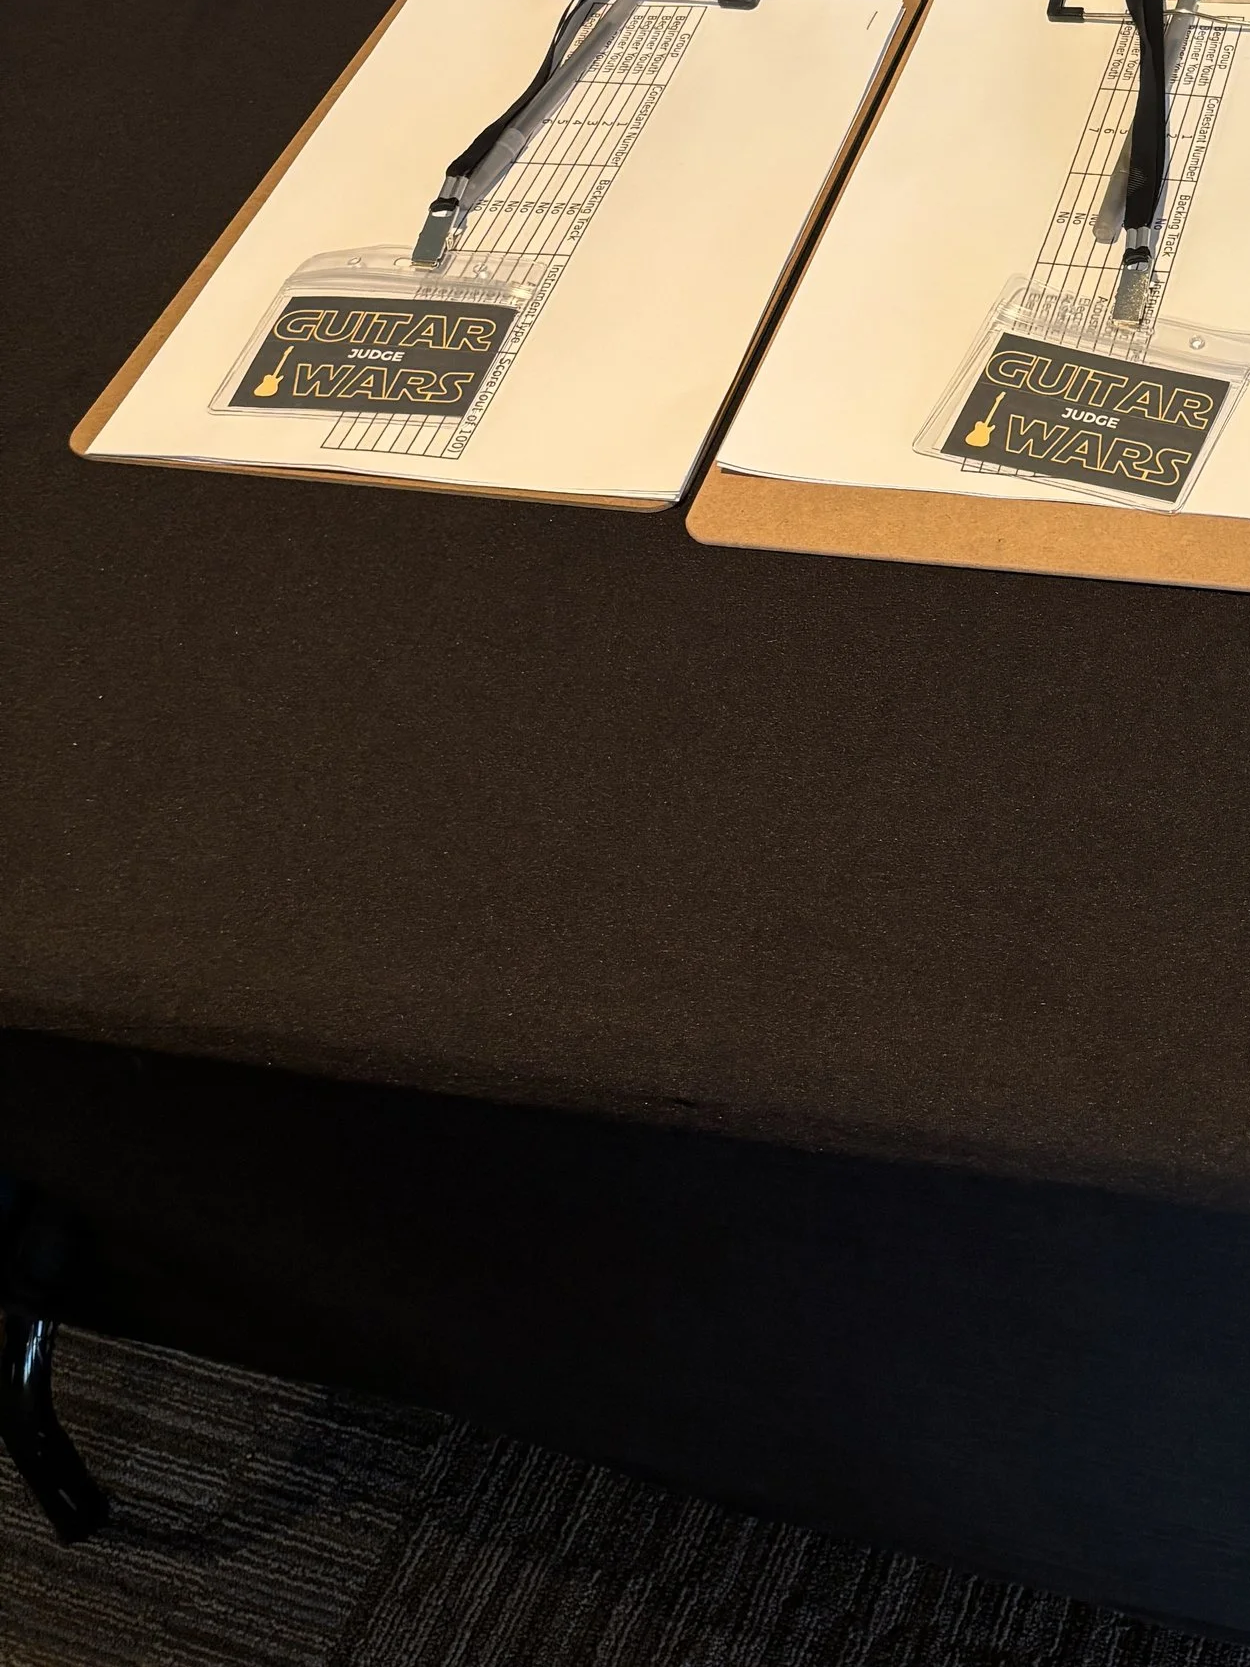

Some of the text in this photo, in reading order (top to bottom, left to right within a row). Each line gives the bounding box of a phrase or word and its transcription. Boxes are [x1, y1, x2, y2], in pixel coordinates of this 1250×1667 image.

[671, 33, 690, 57] Group
[1218, 45, 1234, 69] Group
[611, 86, 663, 167] Contestant Number
[1186, 98, 1219, 181] Contestant Number
[568, 180, 610, 241] Backing Track
[1162, 194, 1190, 257] Backing Track
[273, 309, 497, 351] GUITAR
[511, 265, 563, 343] Instrument Type
[292, 363, 475, 403] WARS
[347, 349, 404, 362] JUDGE
[448, 357, 511, 453] Score (out of 100)
[985, 351, 1213, 430] GUITAR
[1061, 407, 1120, 429] JUDGE
[1005, 414, 1192, 486] WARS
